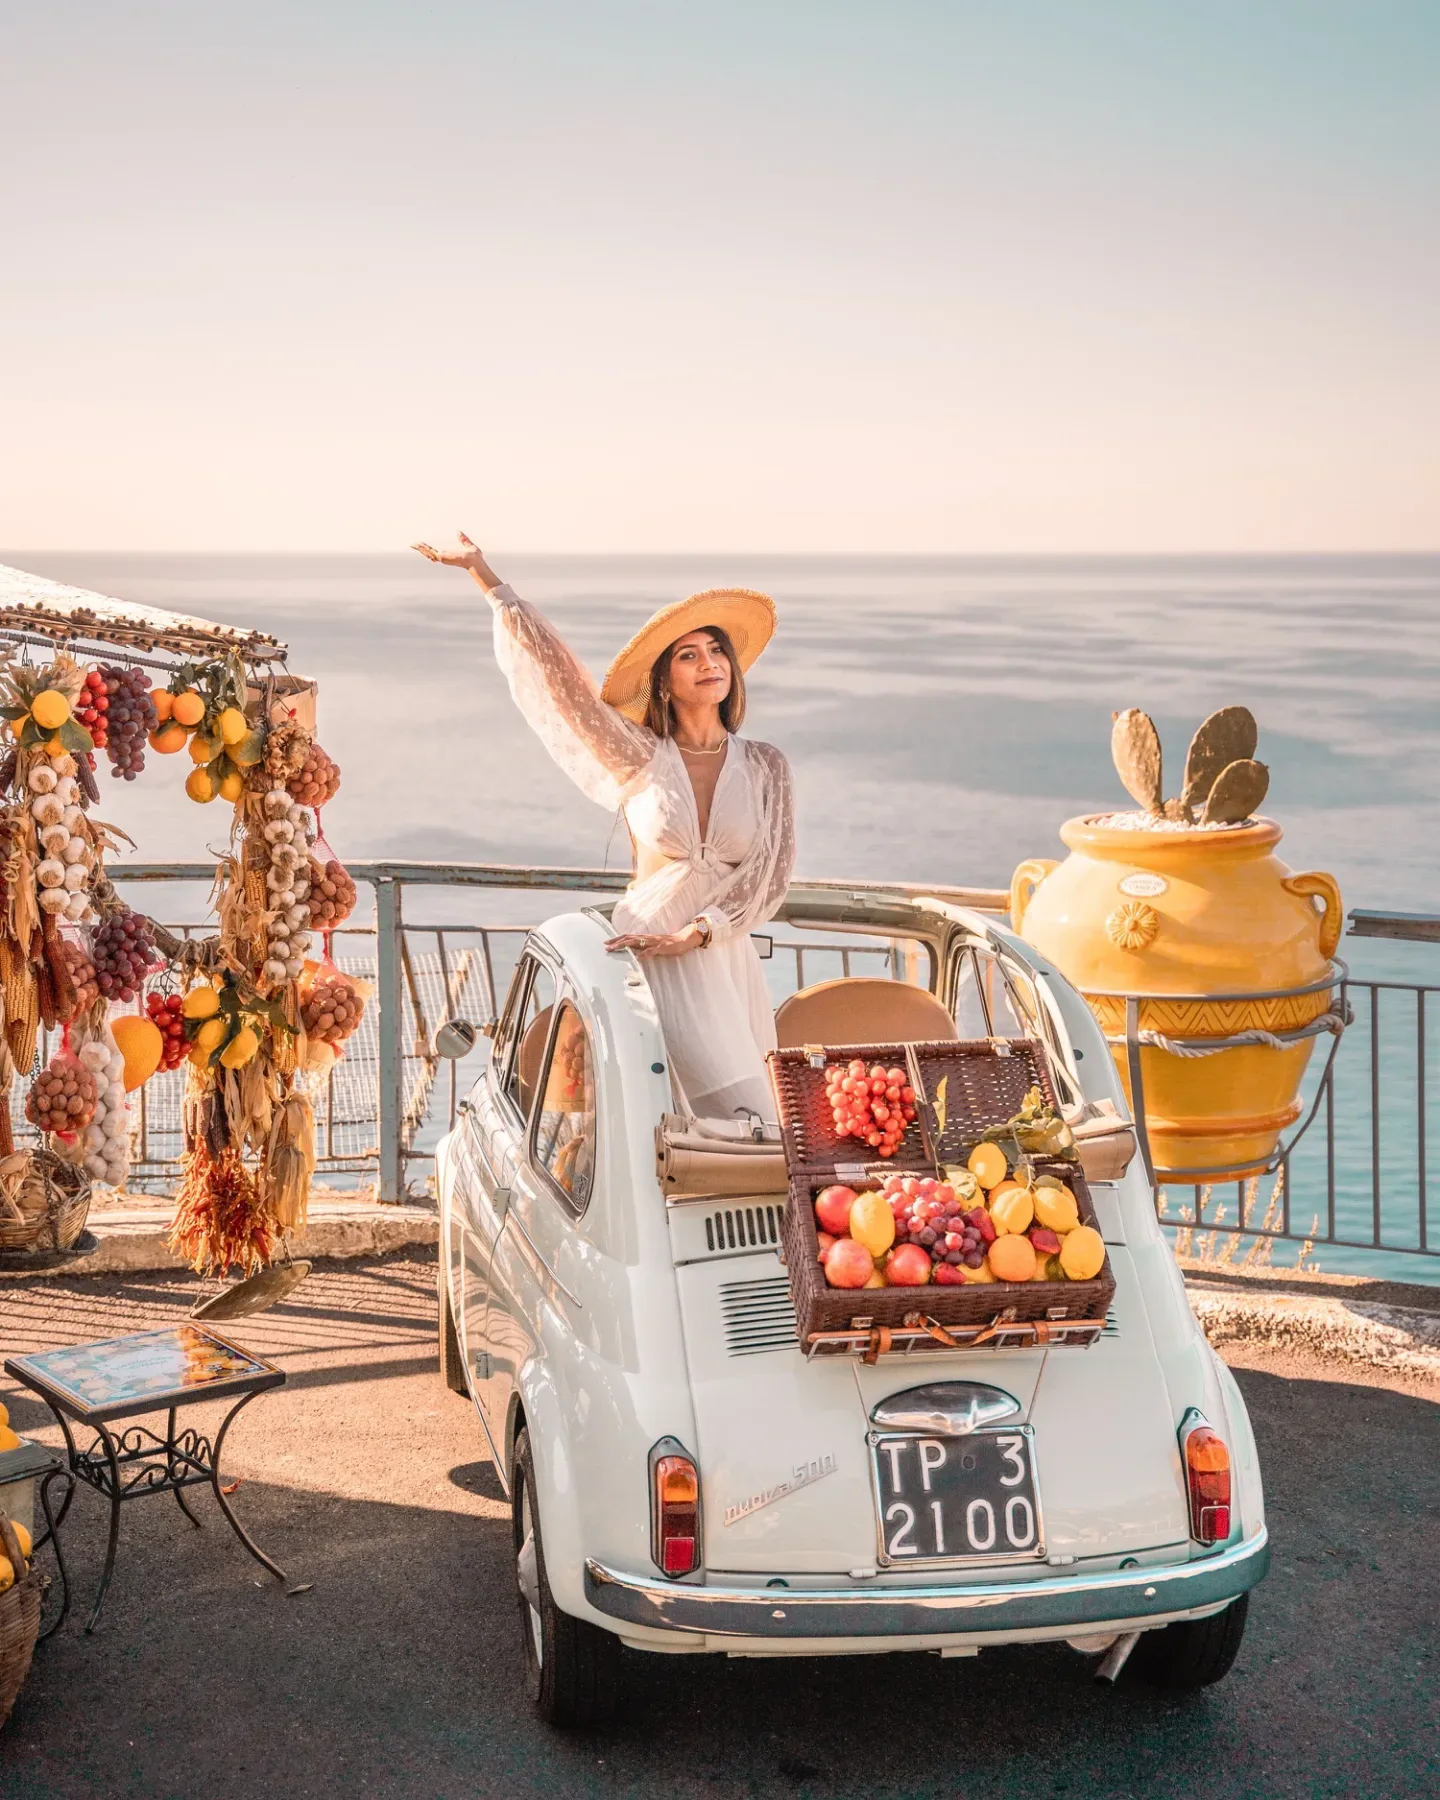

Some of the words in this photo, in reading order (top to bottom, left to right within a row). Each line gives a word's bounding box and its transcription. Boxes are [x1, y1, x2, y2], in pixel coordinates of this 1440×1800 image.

[792, 1451, 837, 1486] 500
[880, 1440, 947, 1493] TP
[996, 1435, 1025, 1487] 3
[885, 1496, 1035, 1556] 2100
